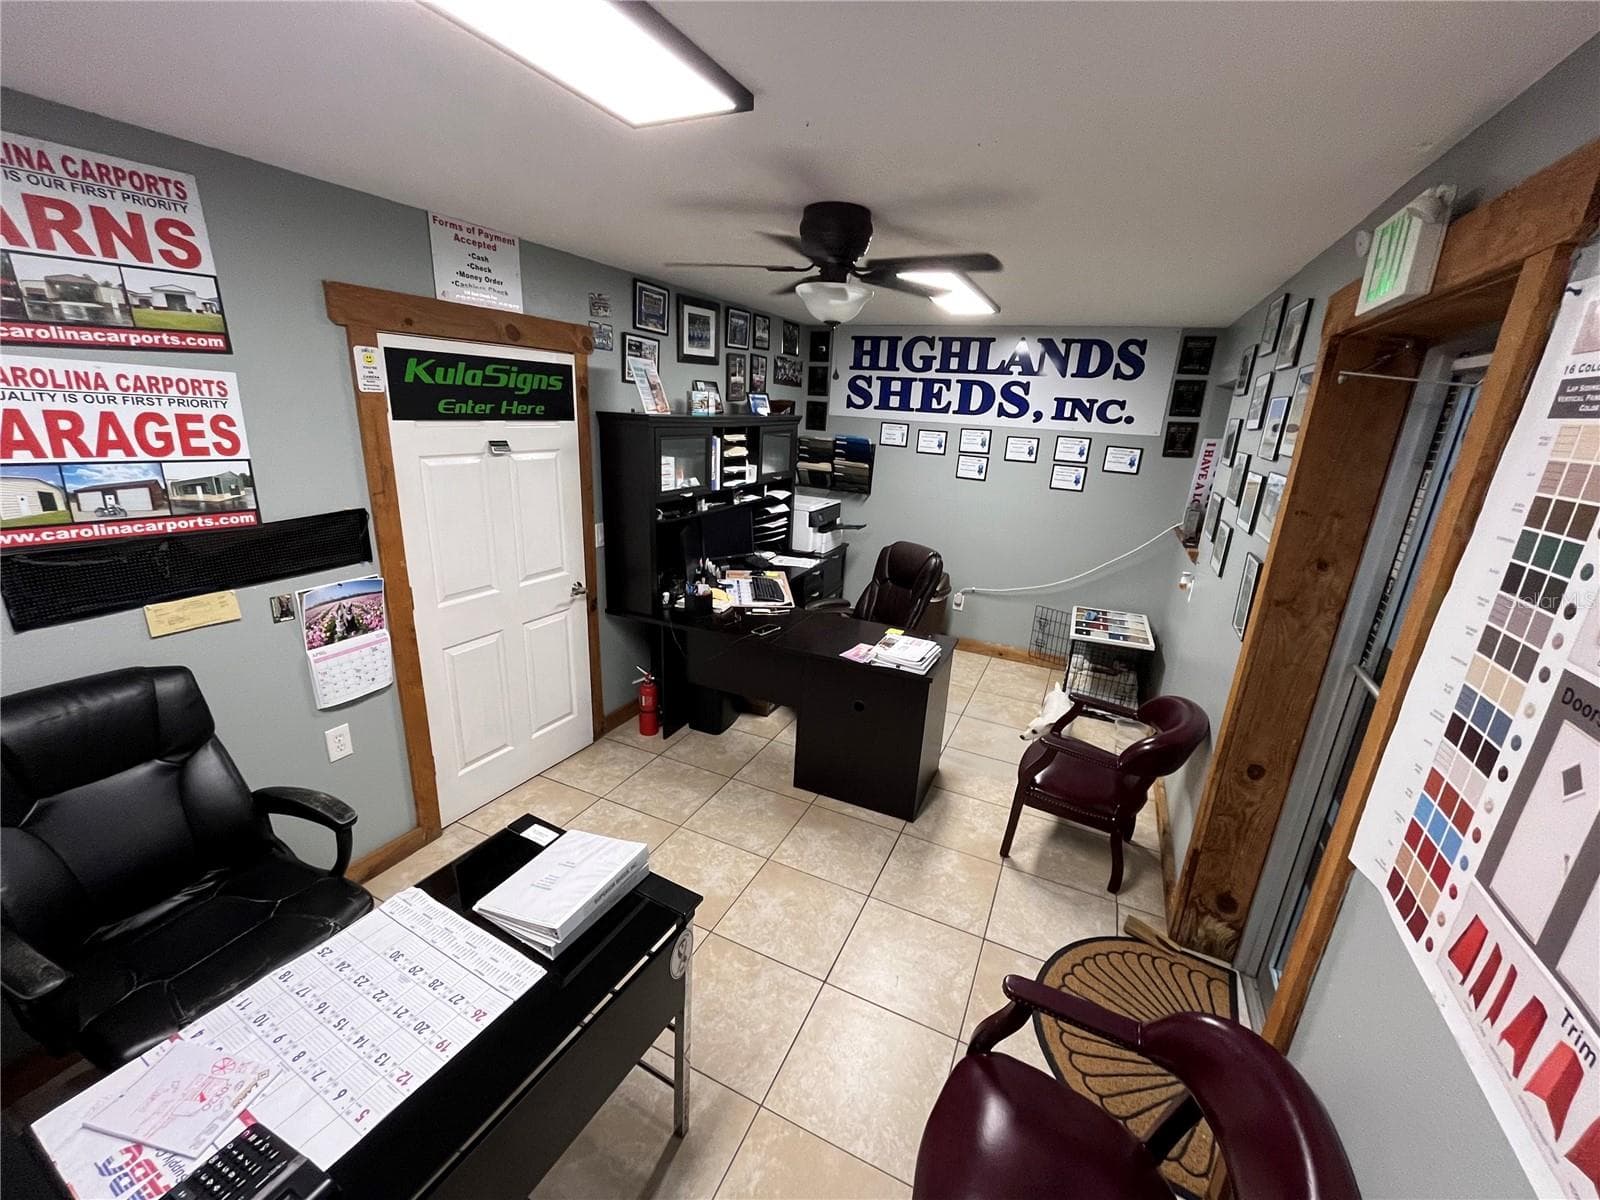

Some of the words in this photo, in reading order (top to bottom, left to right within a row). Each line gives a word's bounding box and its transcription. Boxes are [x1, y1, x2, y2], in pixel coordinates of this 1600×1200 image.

[60, 154, 188, 201] CARPORTS
[3, 168, 21, 182] IS
[26, 174, 67, 192] OUR
[71, 183, 116, 200] FIRST
[122, 193, 189, 214] PRIORITY
[432, 215, 463, 232] Forms
[466, 227, 475, 235] of
[478, 228, 516, 246] Payment
[453, 233, 497, 252] Accepted
[471, 253, 489, 263] Cash
[469, 263, 492, 273] Check
[459, 271, 482, 283] Money
[484, 276, 503, 286] Order
[849, 336, 1147, 381] HIGHLANDS
[1564, 364, 1576, 375] 16
[404, 358, 564, 395] KulaSigns
[115, 373, 229, 397] CARPORTS
[63, 393, 76, 403] IS
[83, 393, 118, 405] OUR
[122, 396, 163, 407] FIRST
[168, 398, 228, 409] PRIORITY
[846, 374, 1043, 424] SHEDS,
[1050, 396, 1135, 425] INC.
[438, 399, 495, 415] Enter
[501, 401, 545, 415] Here
[0, 408, 241, 459] ARAGES
[1197, 449, 1214, 480] HAVE
[1195, 483, 1205, 491] A
[317, 947, 333, 957] 25
[389, 950, 404, 961] 30
[335, 961, 352, 972] 24
[408, 965, 424, 976] 29
[278, 970, 294, 983] 18
[353, 975, 370, 987] 23
[428, 979, 444, 990] 28
[296, 987, 312, 997] 17
[372, 990, 389, 1002] 22
[236, 997, 252, 1011] 11
[448, 994, 465, 1005] 27
[314, 1002, 330, 1014] 16
[392, 1005, 409, 1018] 21
[253, 1014, 270, 1027] 10
[471, 1009, 488, 1022] 26
[333, 1018, 349, 1031] 15
[413, 1021, 430, 1034] 20
[273, 1034, 287, 1043] 9
[353, 1035, 370, 1049] 14
[1560, 1006, 1597, 1069] Trim
[435, 1039, 451, 1052] 19
[292, 1051, 306, 1062] 8
[374, 1052, 391, 1067] 13
[312, 1070, 327, 1082] 7
[396, 1070, 413, 1086] 12
[333, 1089, 347, 1101] 6
[354, 1109, 370, 1123] 5
